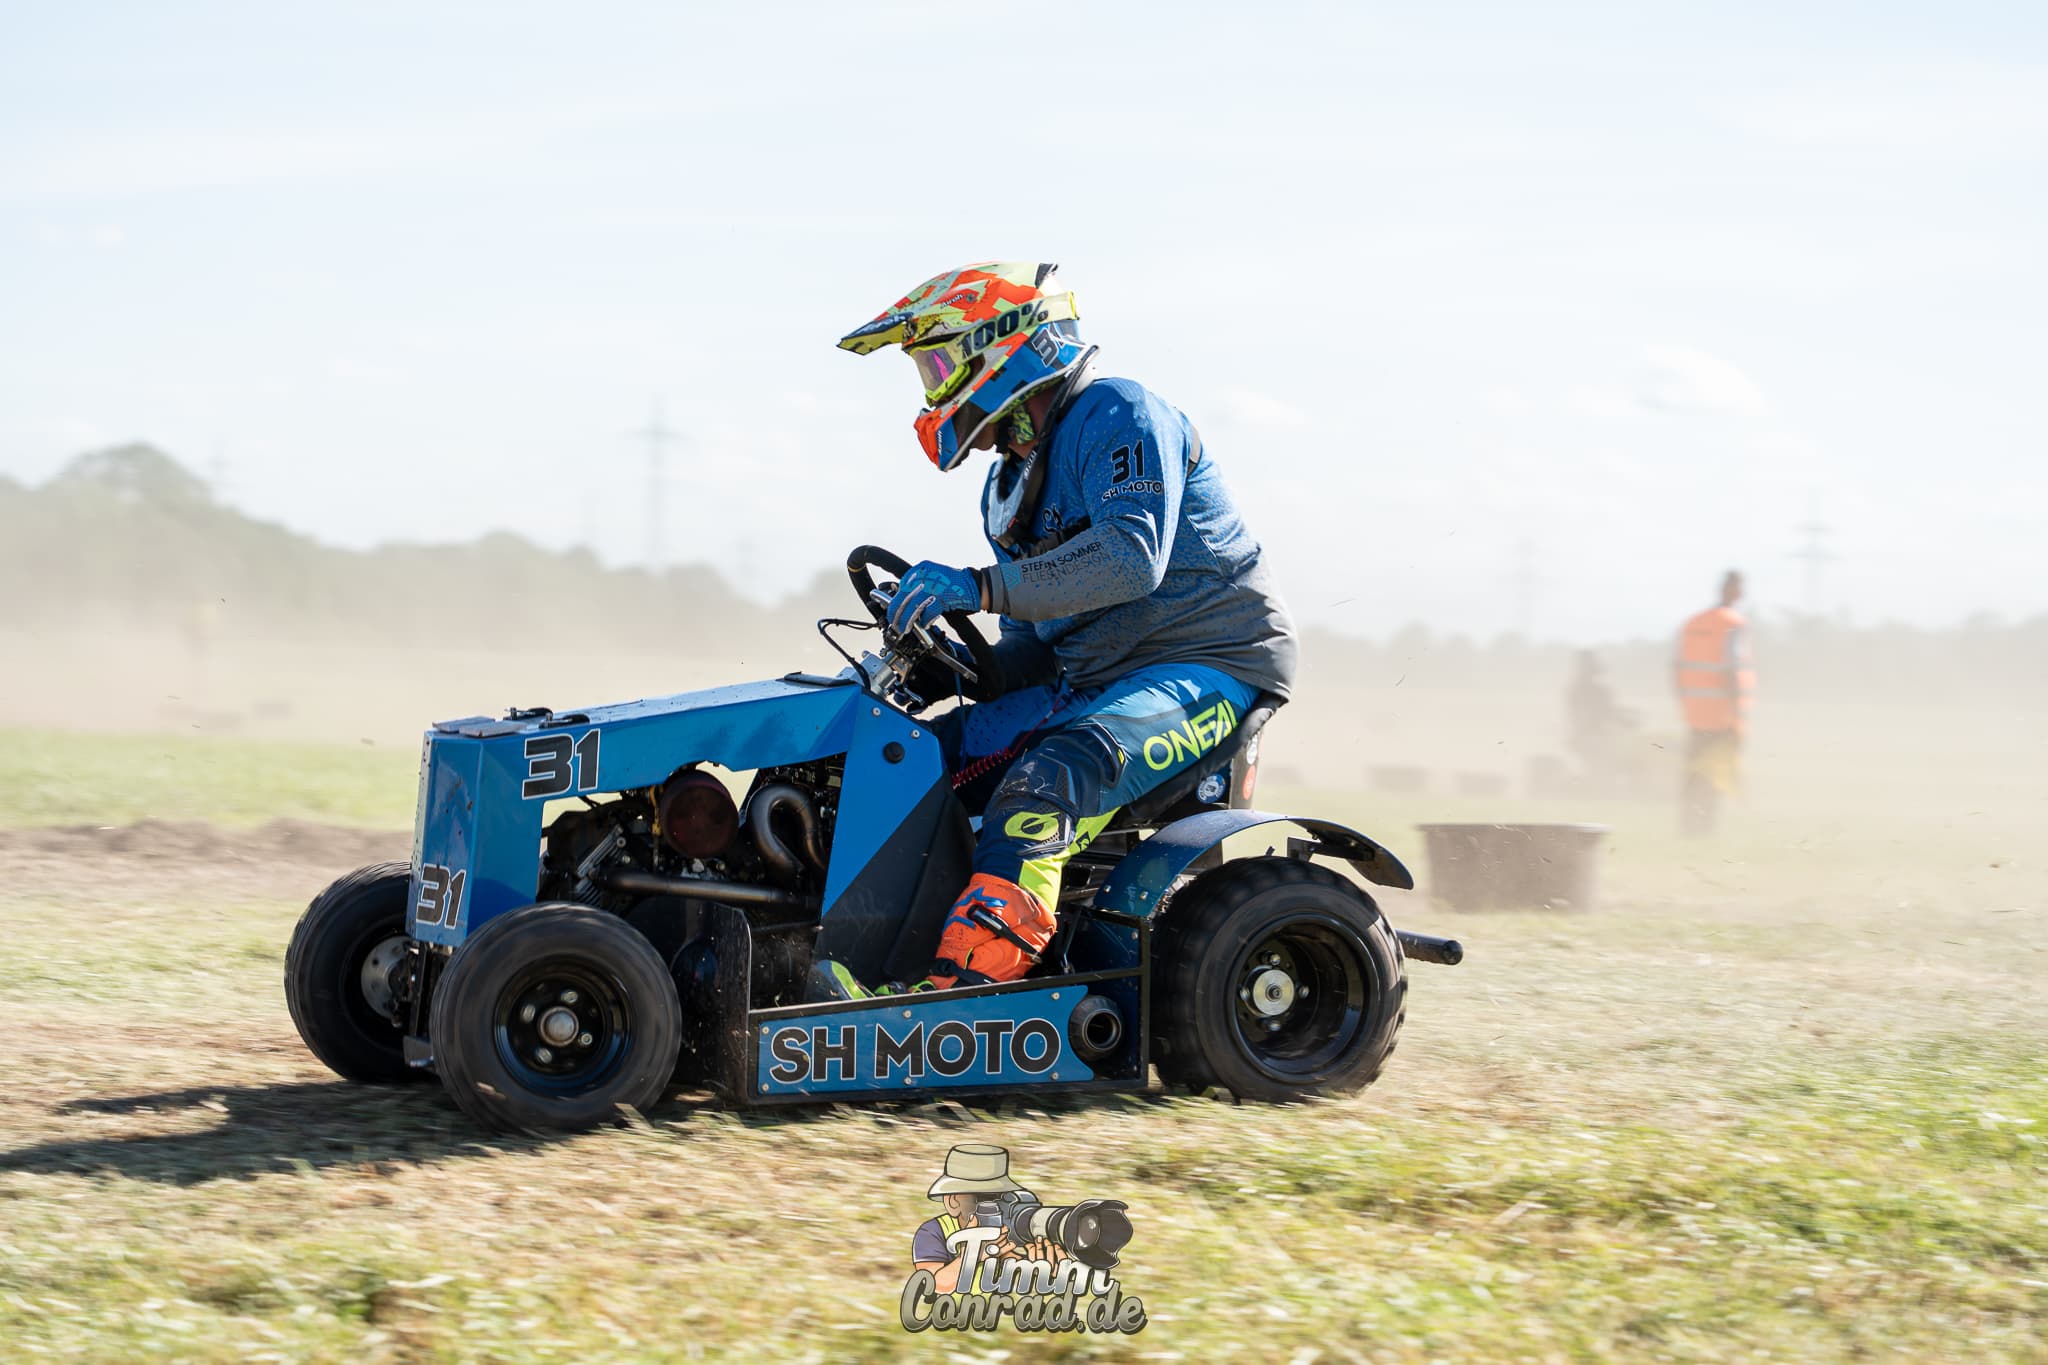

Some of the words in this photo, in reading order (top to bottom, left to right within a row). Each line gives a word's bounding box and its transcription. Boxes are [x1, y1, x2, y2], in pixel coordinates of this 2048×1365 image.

[957, 299, 1049, 361] 100%
[1111, 439, 1145, 485] 31
[1102, 487, 1120, 502] SH
[1121, 480, 1164, 494] MOTO
[1022, 551, 1110, 584] FLIESNDESIGN
[1057, 541, 1105, 566] SOMMER
[521, 728, 601, 800] 31
[415, 862, 467, 929] 31
[769, 1025, 857, 1084] SH
[873, 1017, 1061, 1080] MOTO
